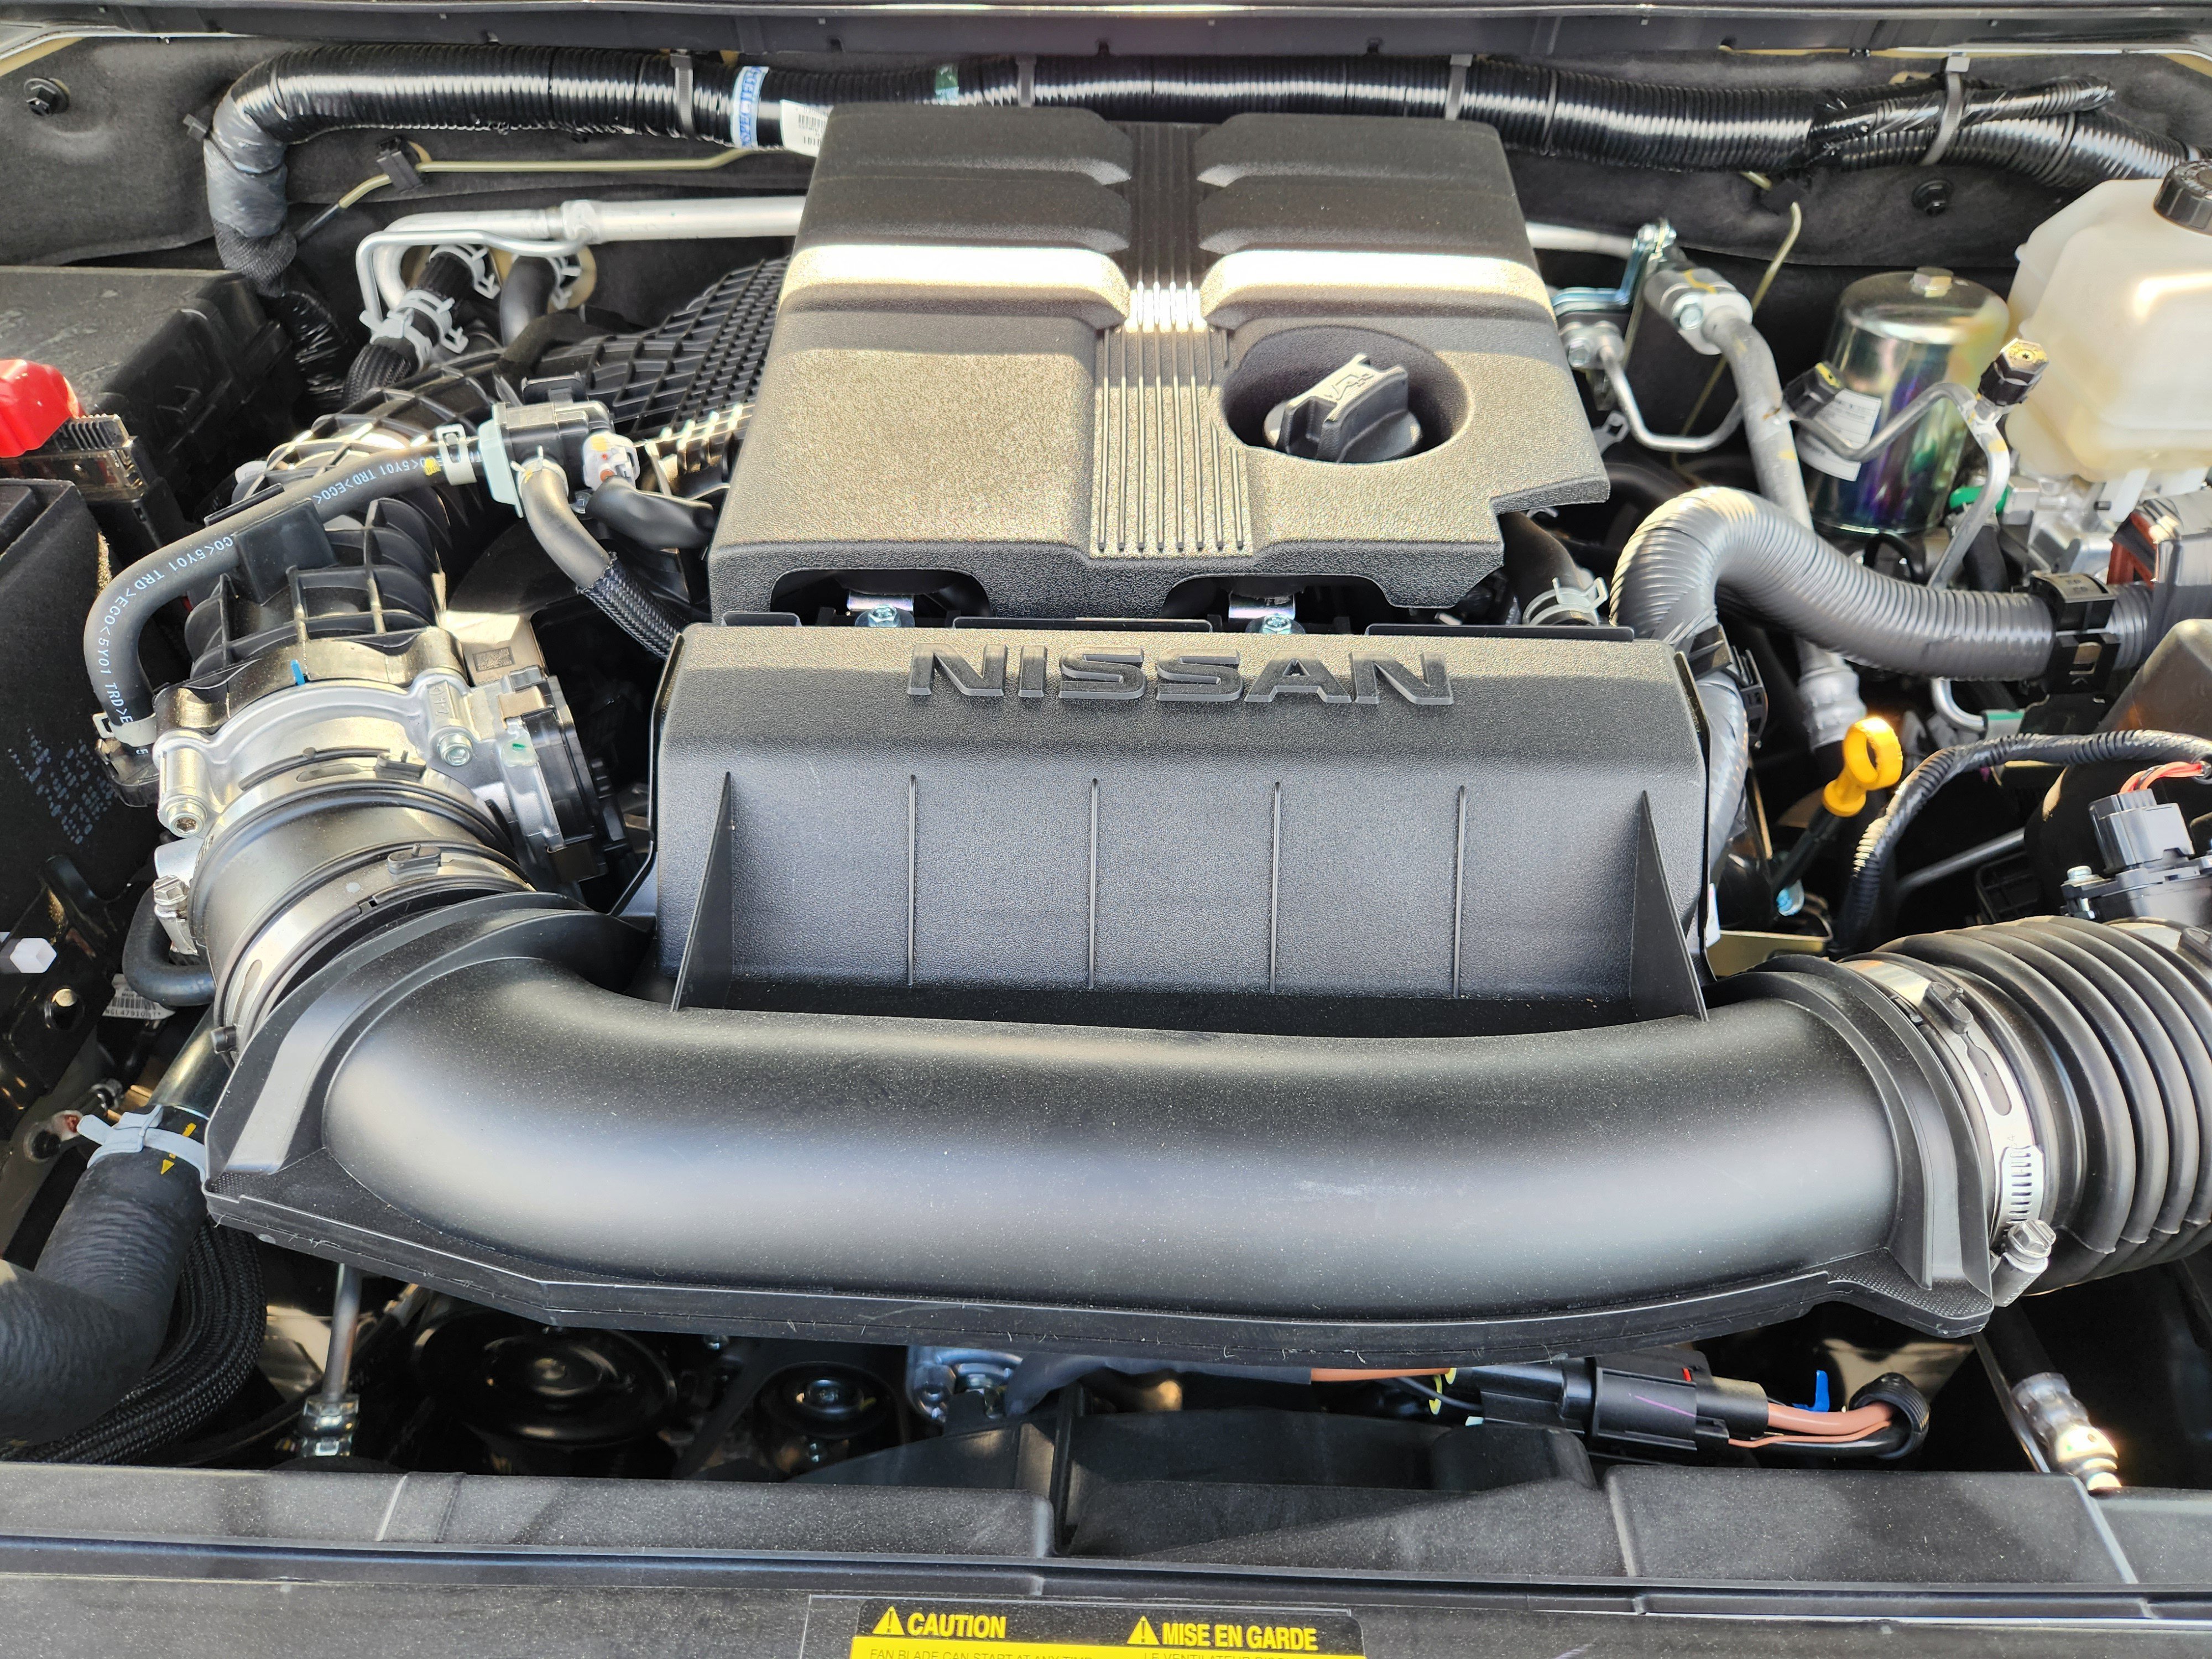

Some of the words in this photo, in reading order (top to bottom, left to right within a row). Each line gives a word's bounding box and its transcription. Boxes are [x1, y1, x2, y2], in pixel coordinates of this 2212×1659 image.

[169, 532, 235, 572] CO<5Y01
[907, 642, 1454, 705] NISSAN
[907, 1612, 1006, 1639] CAUTION
[1162, 1622, 1211, 1646] MISE
[1214, 1624, 1243, 1647] EN
[1246, 1625, 1318, 1651] GARDE
[870, 1648, 894, 1659] FAN
[898, 1650, 939, 1659] BLADE
